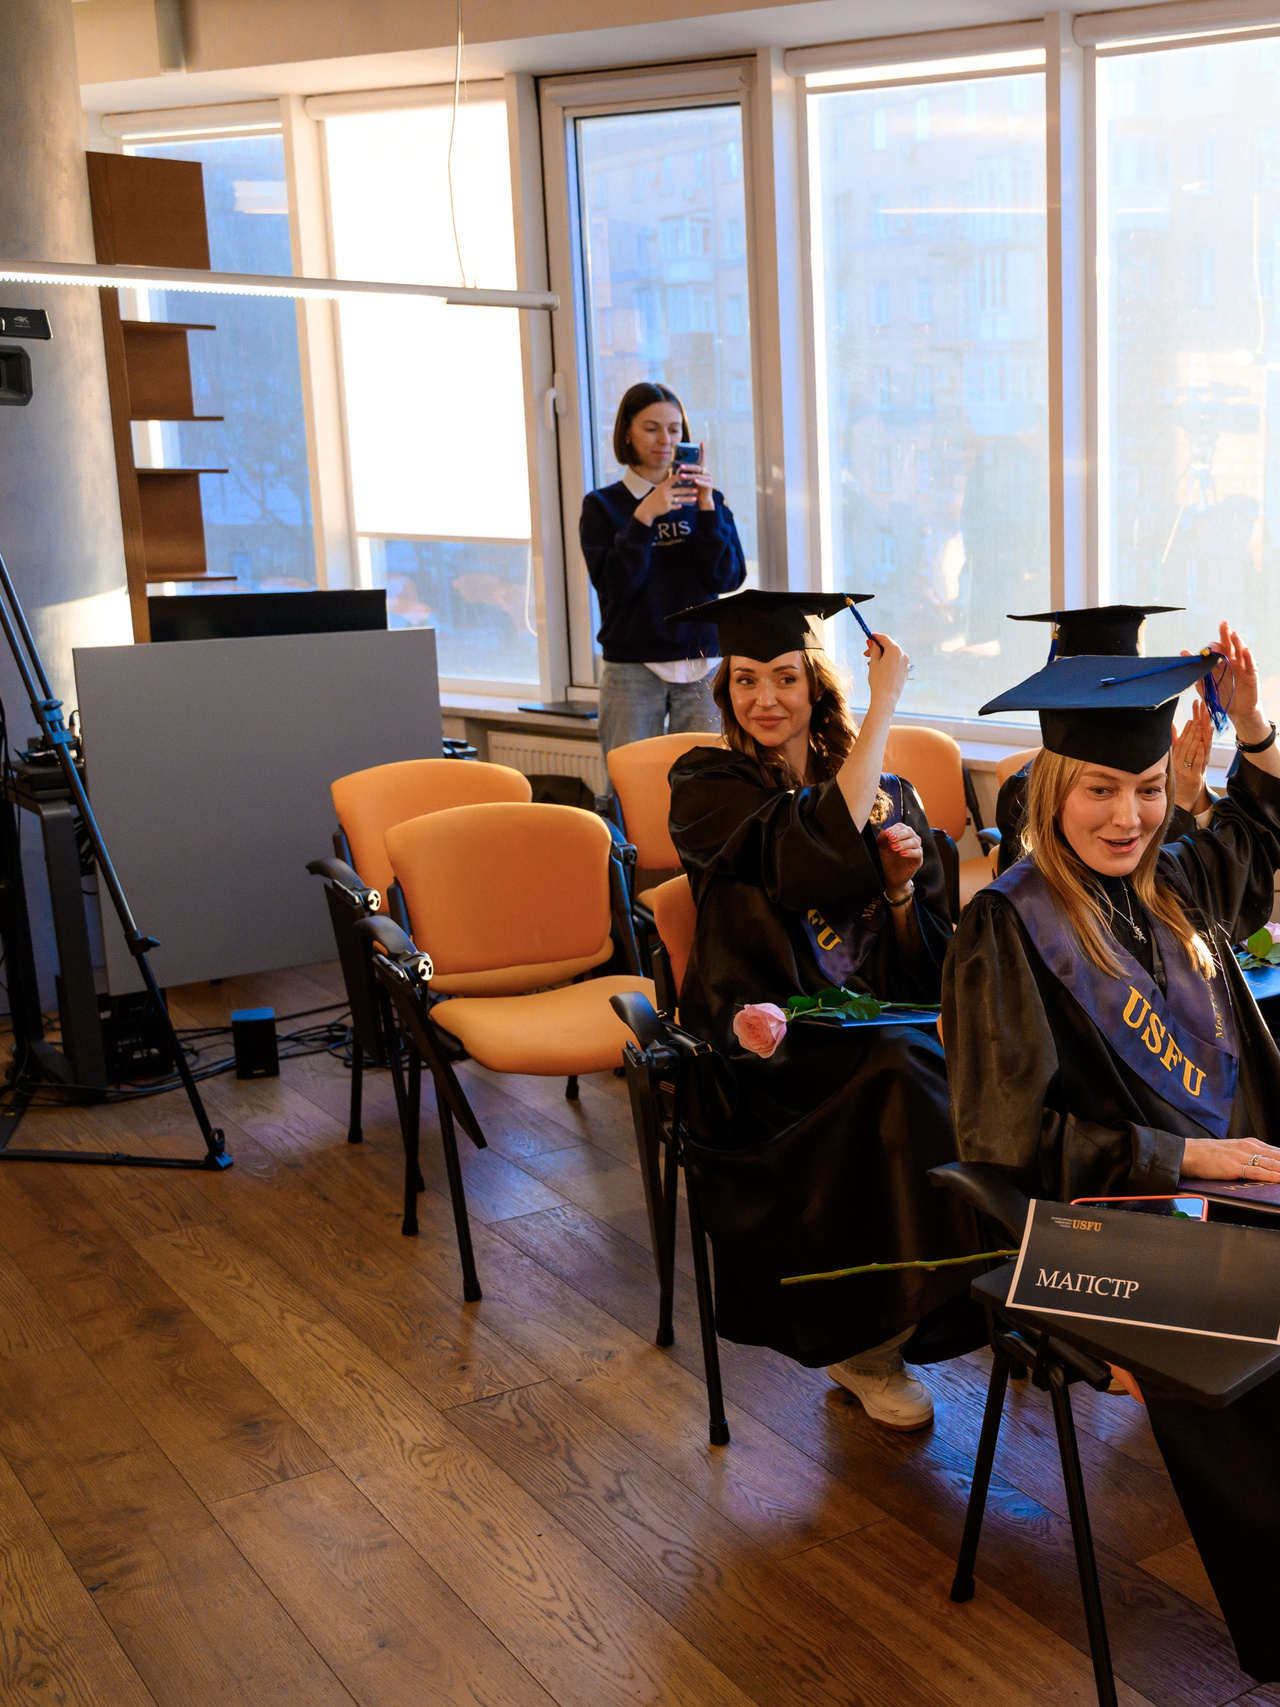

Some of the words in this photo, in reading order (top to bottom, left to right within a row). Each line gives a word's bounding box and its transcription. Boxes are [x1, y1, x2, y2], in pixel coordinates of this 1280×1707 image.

[655, 520, 691, 539] RIS
[807, 908, 843, 951] FU
[1122, 985, 1206, 1096] USFU
[1072, 1219, 1103, 1232] USFU
[1035, 1268, 1139, 1299] МАГІСТР
